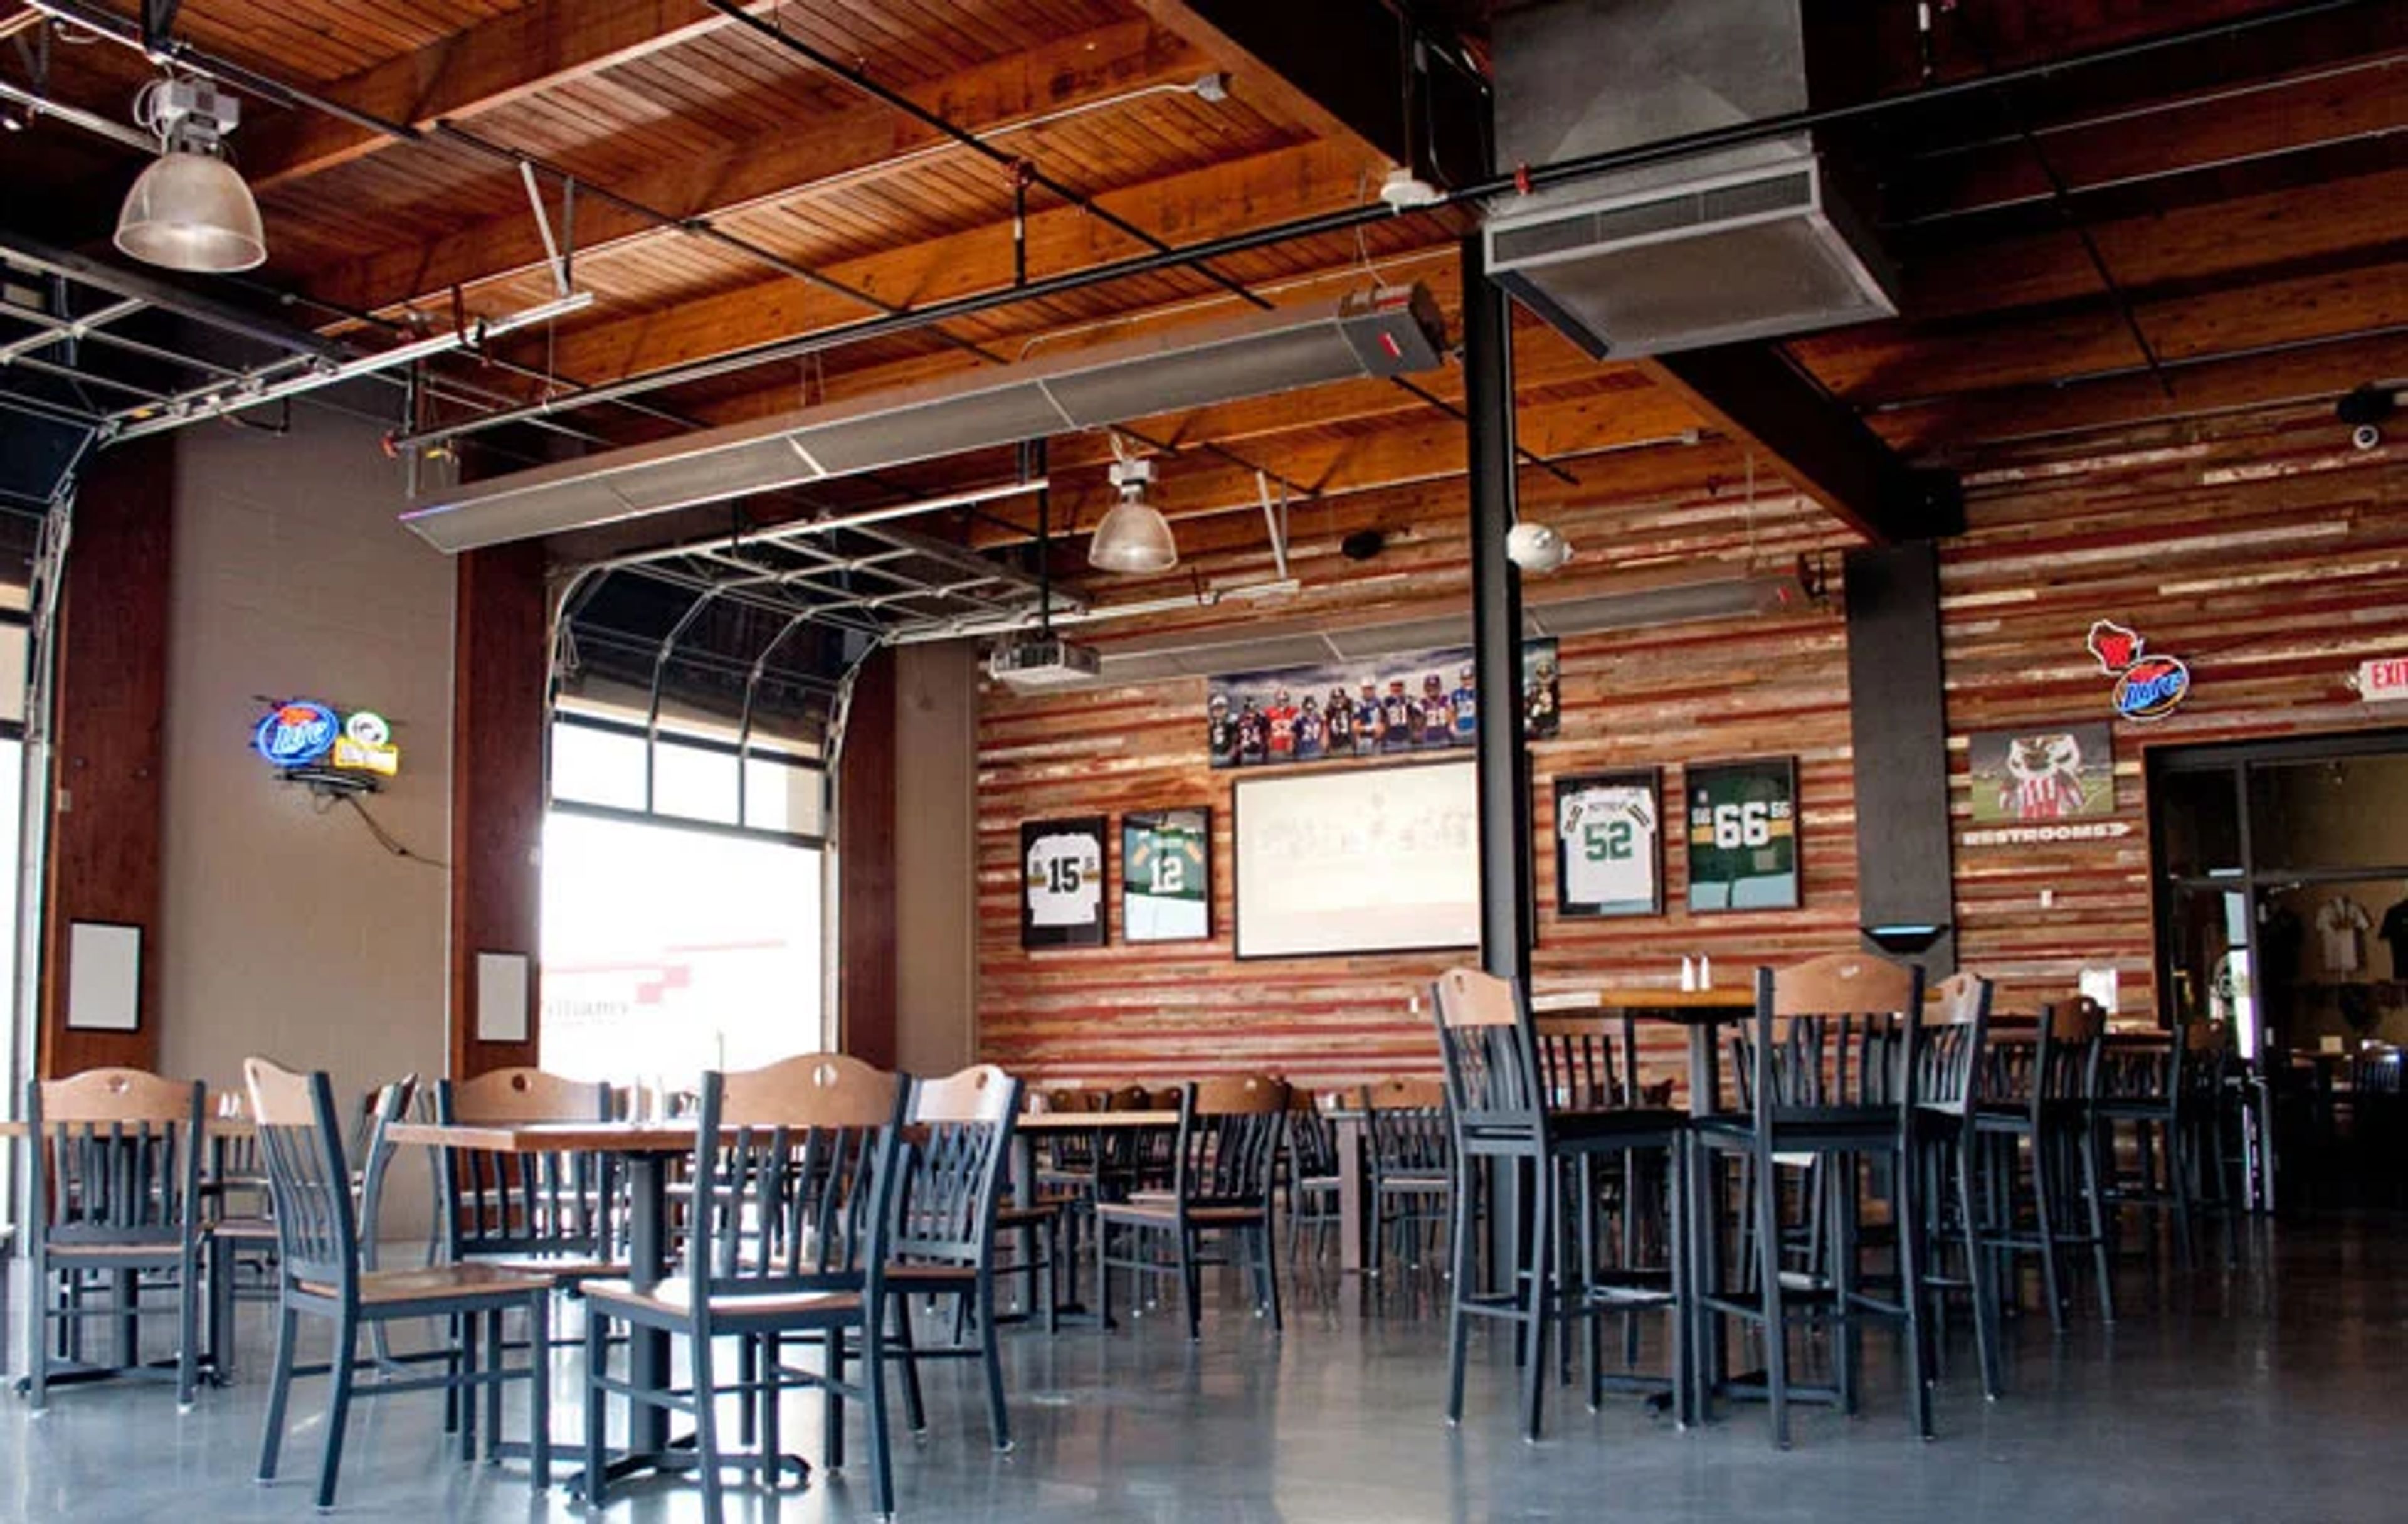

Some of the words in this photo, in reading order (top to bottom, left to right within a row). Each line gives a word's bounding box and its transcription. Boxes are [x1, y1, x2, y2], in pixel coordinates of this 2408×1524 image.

[1585, 821, 1633, 860] 52
[1715, 802, 1769, 848] 66
[1963, 823, 2108, 846] RESTROOMS
[1048, 857, 1080, 893] 15
[1149, 855, 1183, 893] 12
